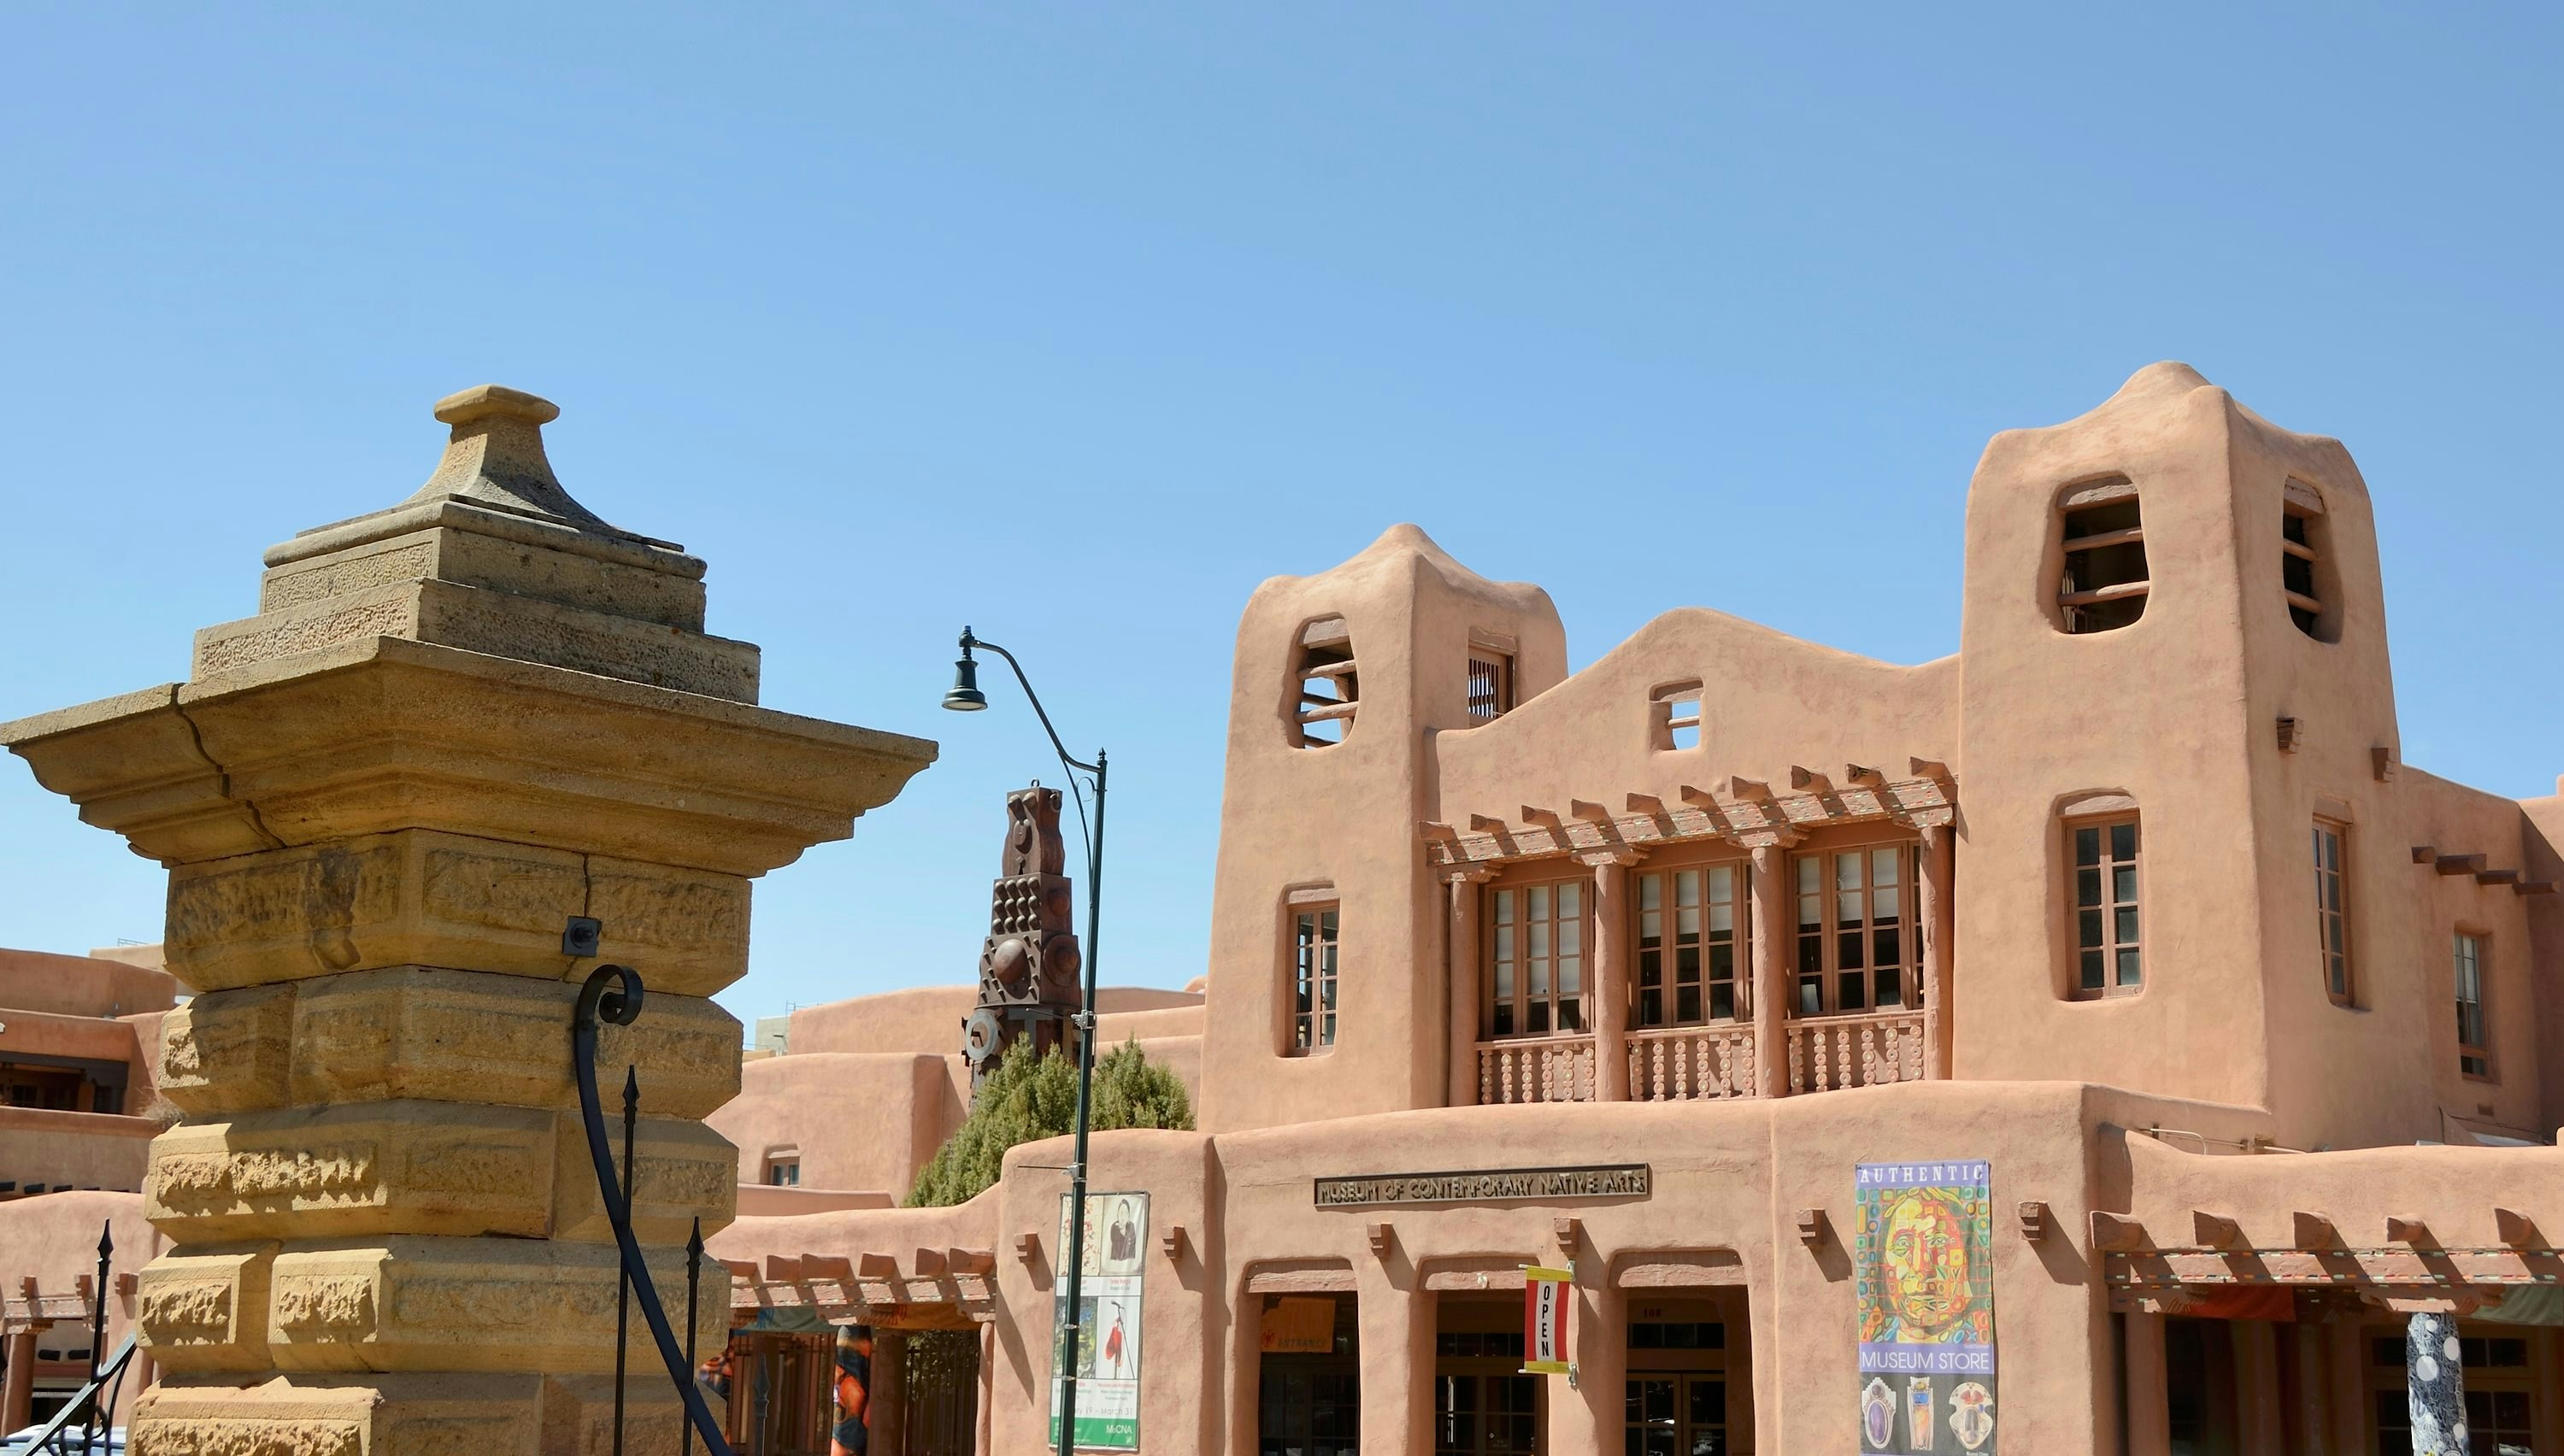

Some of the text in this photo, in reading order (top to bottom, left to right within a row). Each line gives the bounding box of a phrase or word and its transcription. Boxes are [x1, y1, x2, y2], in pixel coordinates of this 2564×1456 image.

[1860, 1165, 1983, 1183] AUTHENTIC
[1321, 1171, 1646, 1203] MUSEUM OF CONTEMPORARY NATIVE ARTS
[1541, 1285, 1550, 1357] OPEN
[1278, 1338, 1326, 1347] ENTRANCE
[1861, 1352, 1990, 1370] MUSEUM STORE
[1101, 1407, 1122, 1416] March
[1125, 1407, 1132, 1416] 31
